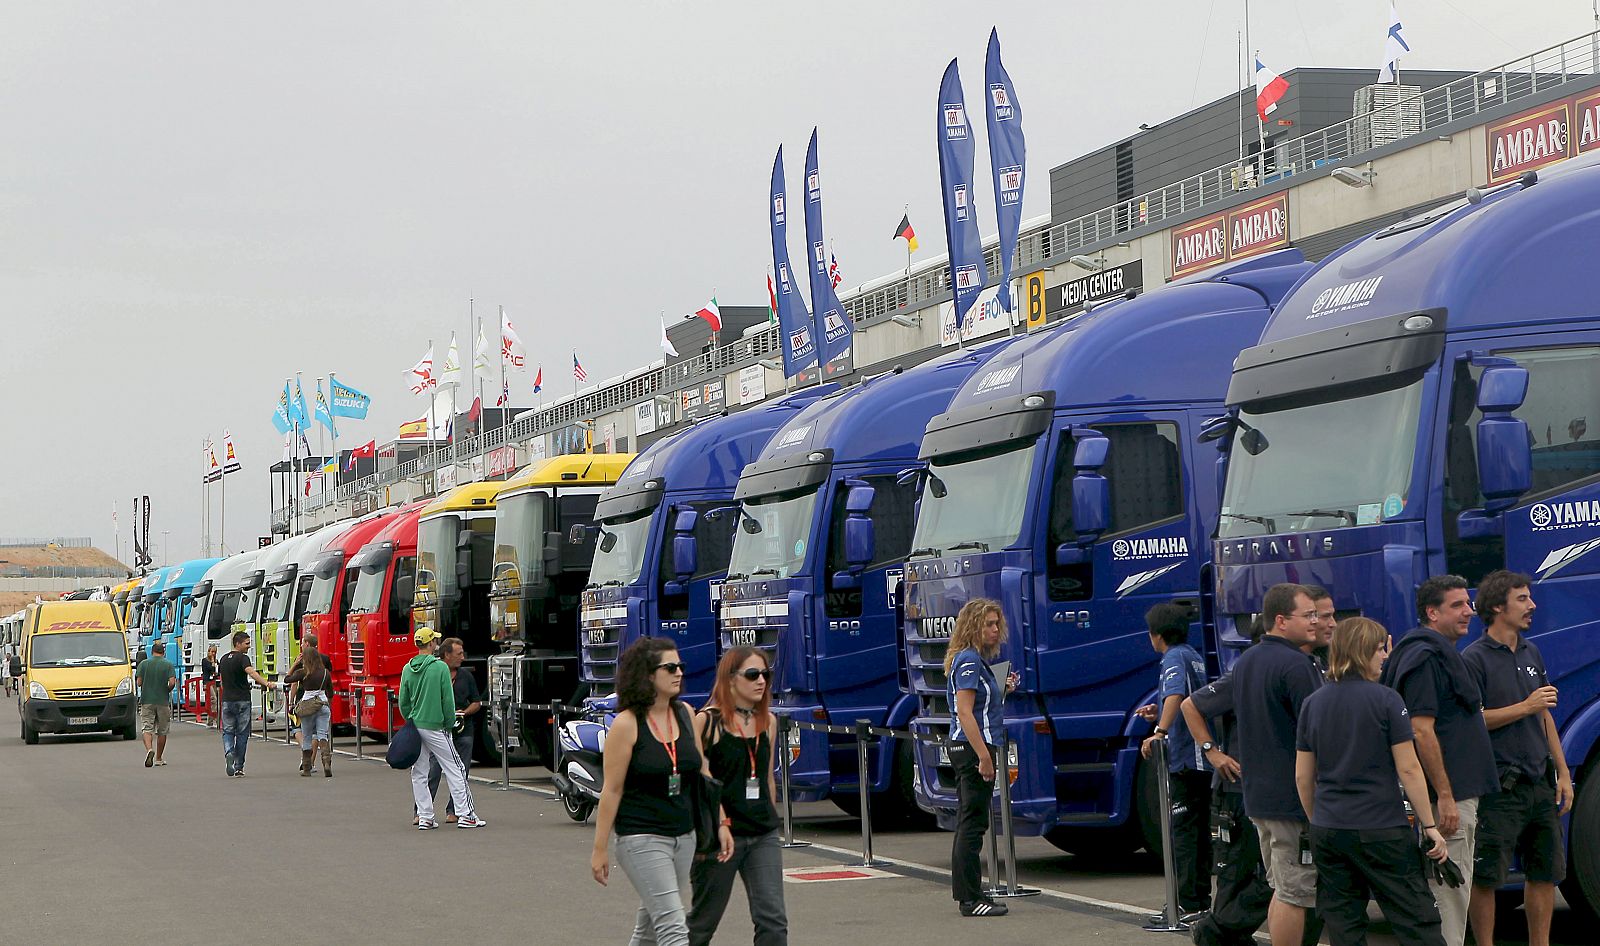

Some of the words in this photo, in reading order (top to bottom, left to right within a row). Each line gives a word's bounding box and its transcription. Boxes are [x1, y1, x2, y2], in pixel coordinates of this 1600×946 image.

[1493, 119, 1564, 172] AMBAR
[1232, 208, 1282, 250] AMBAR
[1175, 227, 1222, 267] AMBAR
[1061, 282, 1088, 307] MEDIA
[1089, 268, 1124, 297] CENTER
[1324, 276, 1384, 309] YAMAHA
[1029, 276, 1041, 322] B
[1531, 523, 1583, 532] FACTORY
[1129, 537, 1188, 555] YAMAHA
[1223, 536, 1333, 556] STRALIS
[48, 621, 106, 631] DHL
[661, 621, 688, 630] 500
[829, 620, 861, 630] 500
[1052, 610, 1090, 623] 450
[922, 616, 956, 638] IVECO
[732, 629, 756, 646] IVECO
